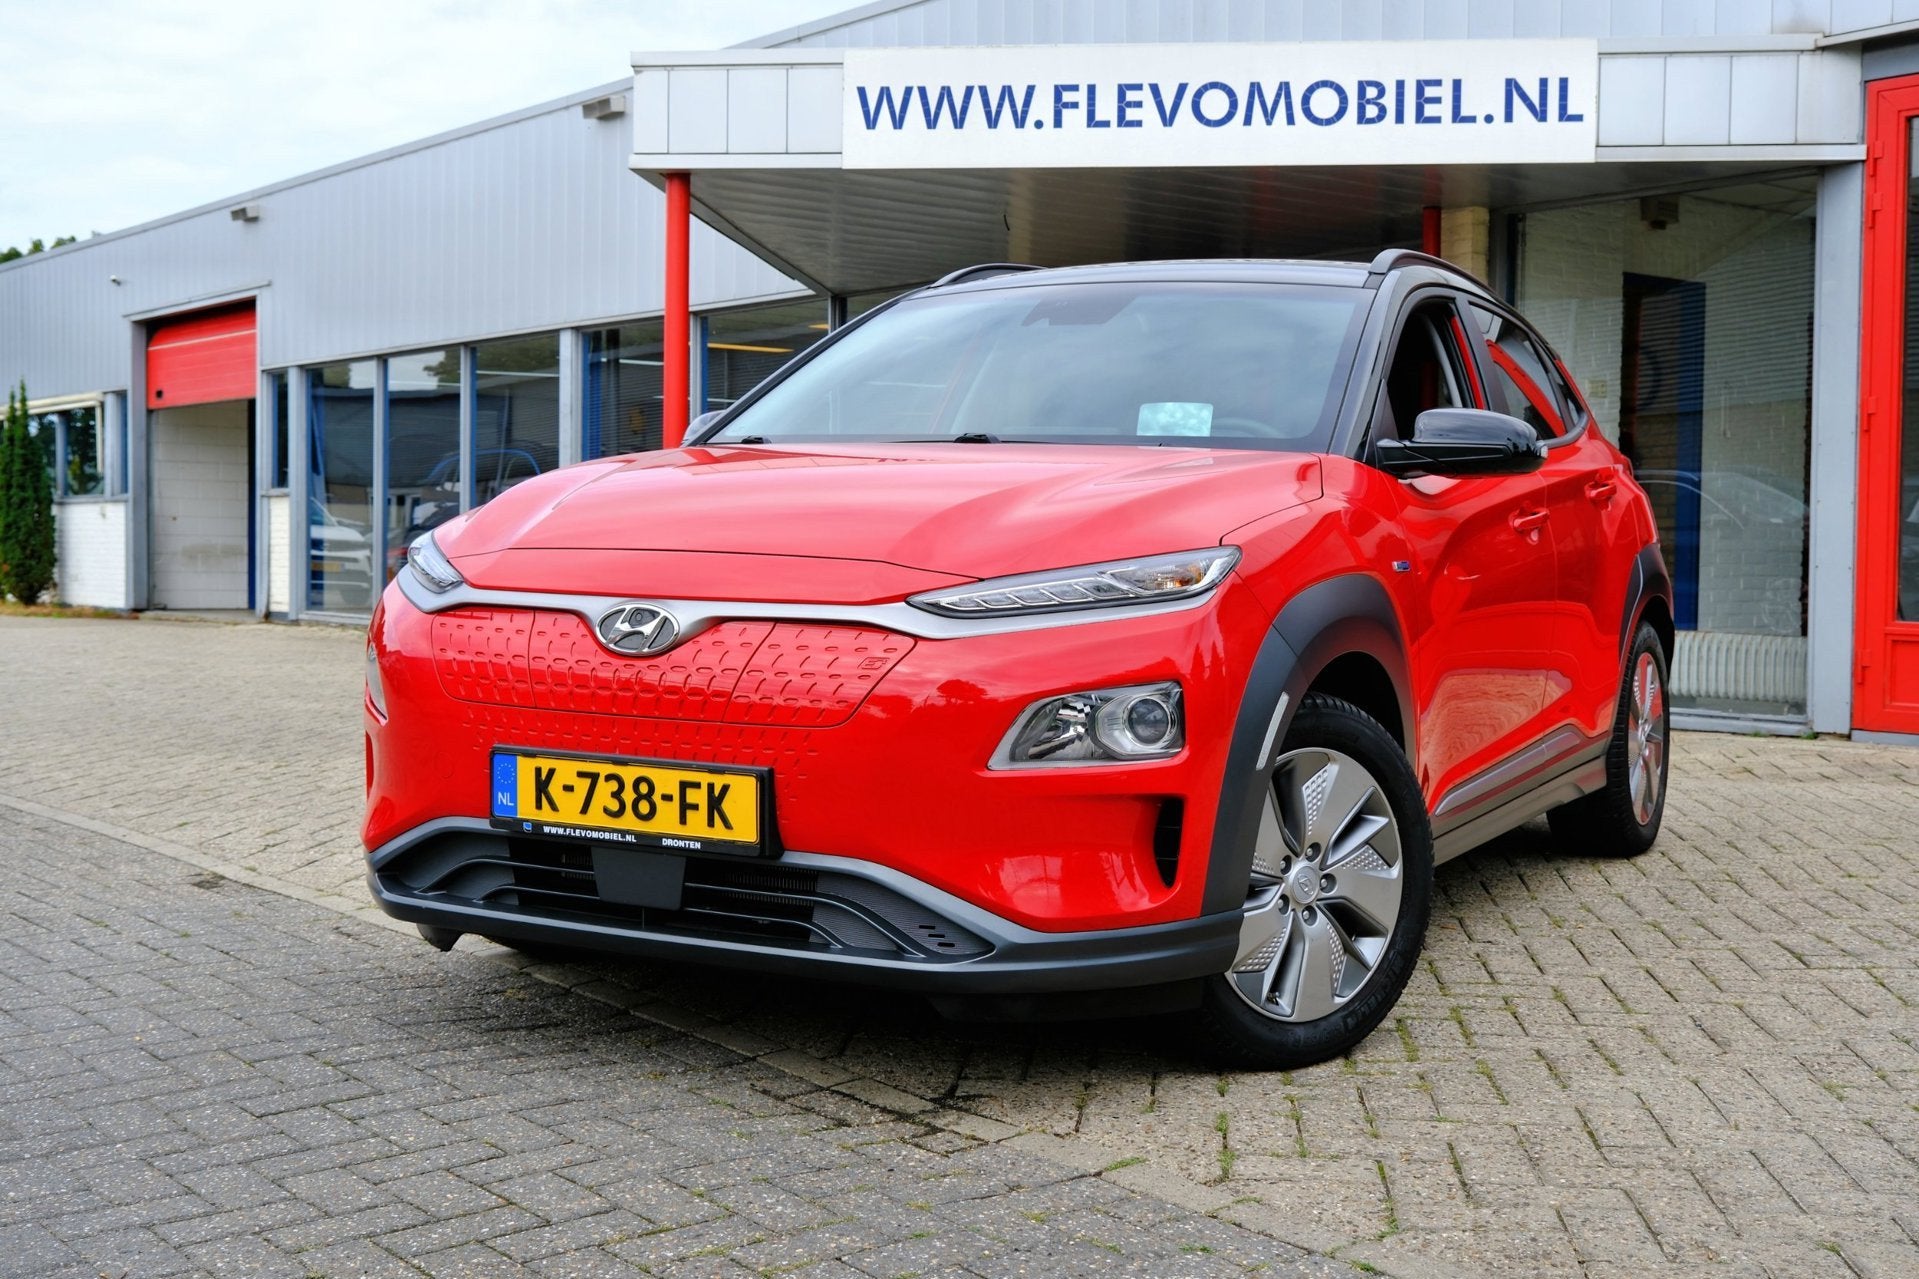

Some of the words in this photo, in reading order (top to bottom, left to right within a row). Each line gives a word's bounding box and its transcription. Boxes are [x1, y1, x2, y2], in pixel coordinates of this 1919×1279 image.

[856, 77, 1584, 130] WWW.FLEVOMOBIEL.NL
[497, 791, 515, 806] NL
[534, 765, 734, 830] K-738-FK
[543, 825, 637, 842] WWW.FLEVOMOBIEL.NL
[661, 837, 701, 849] DRONTEN
